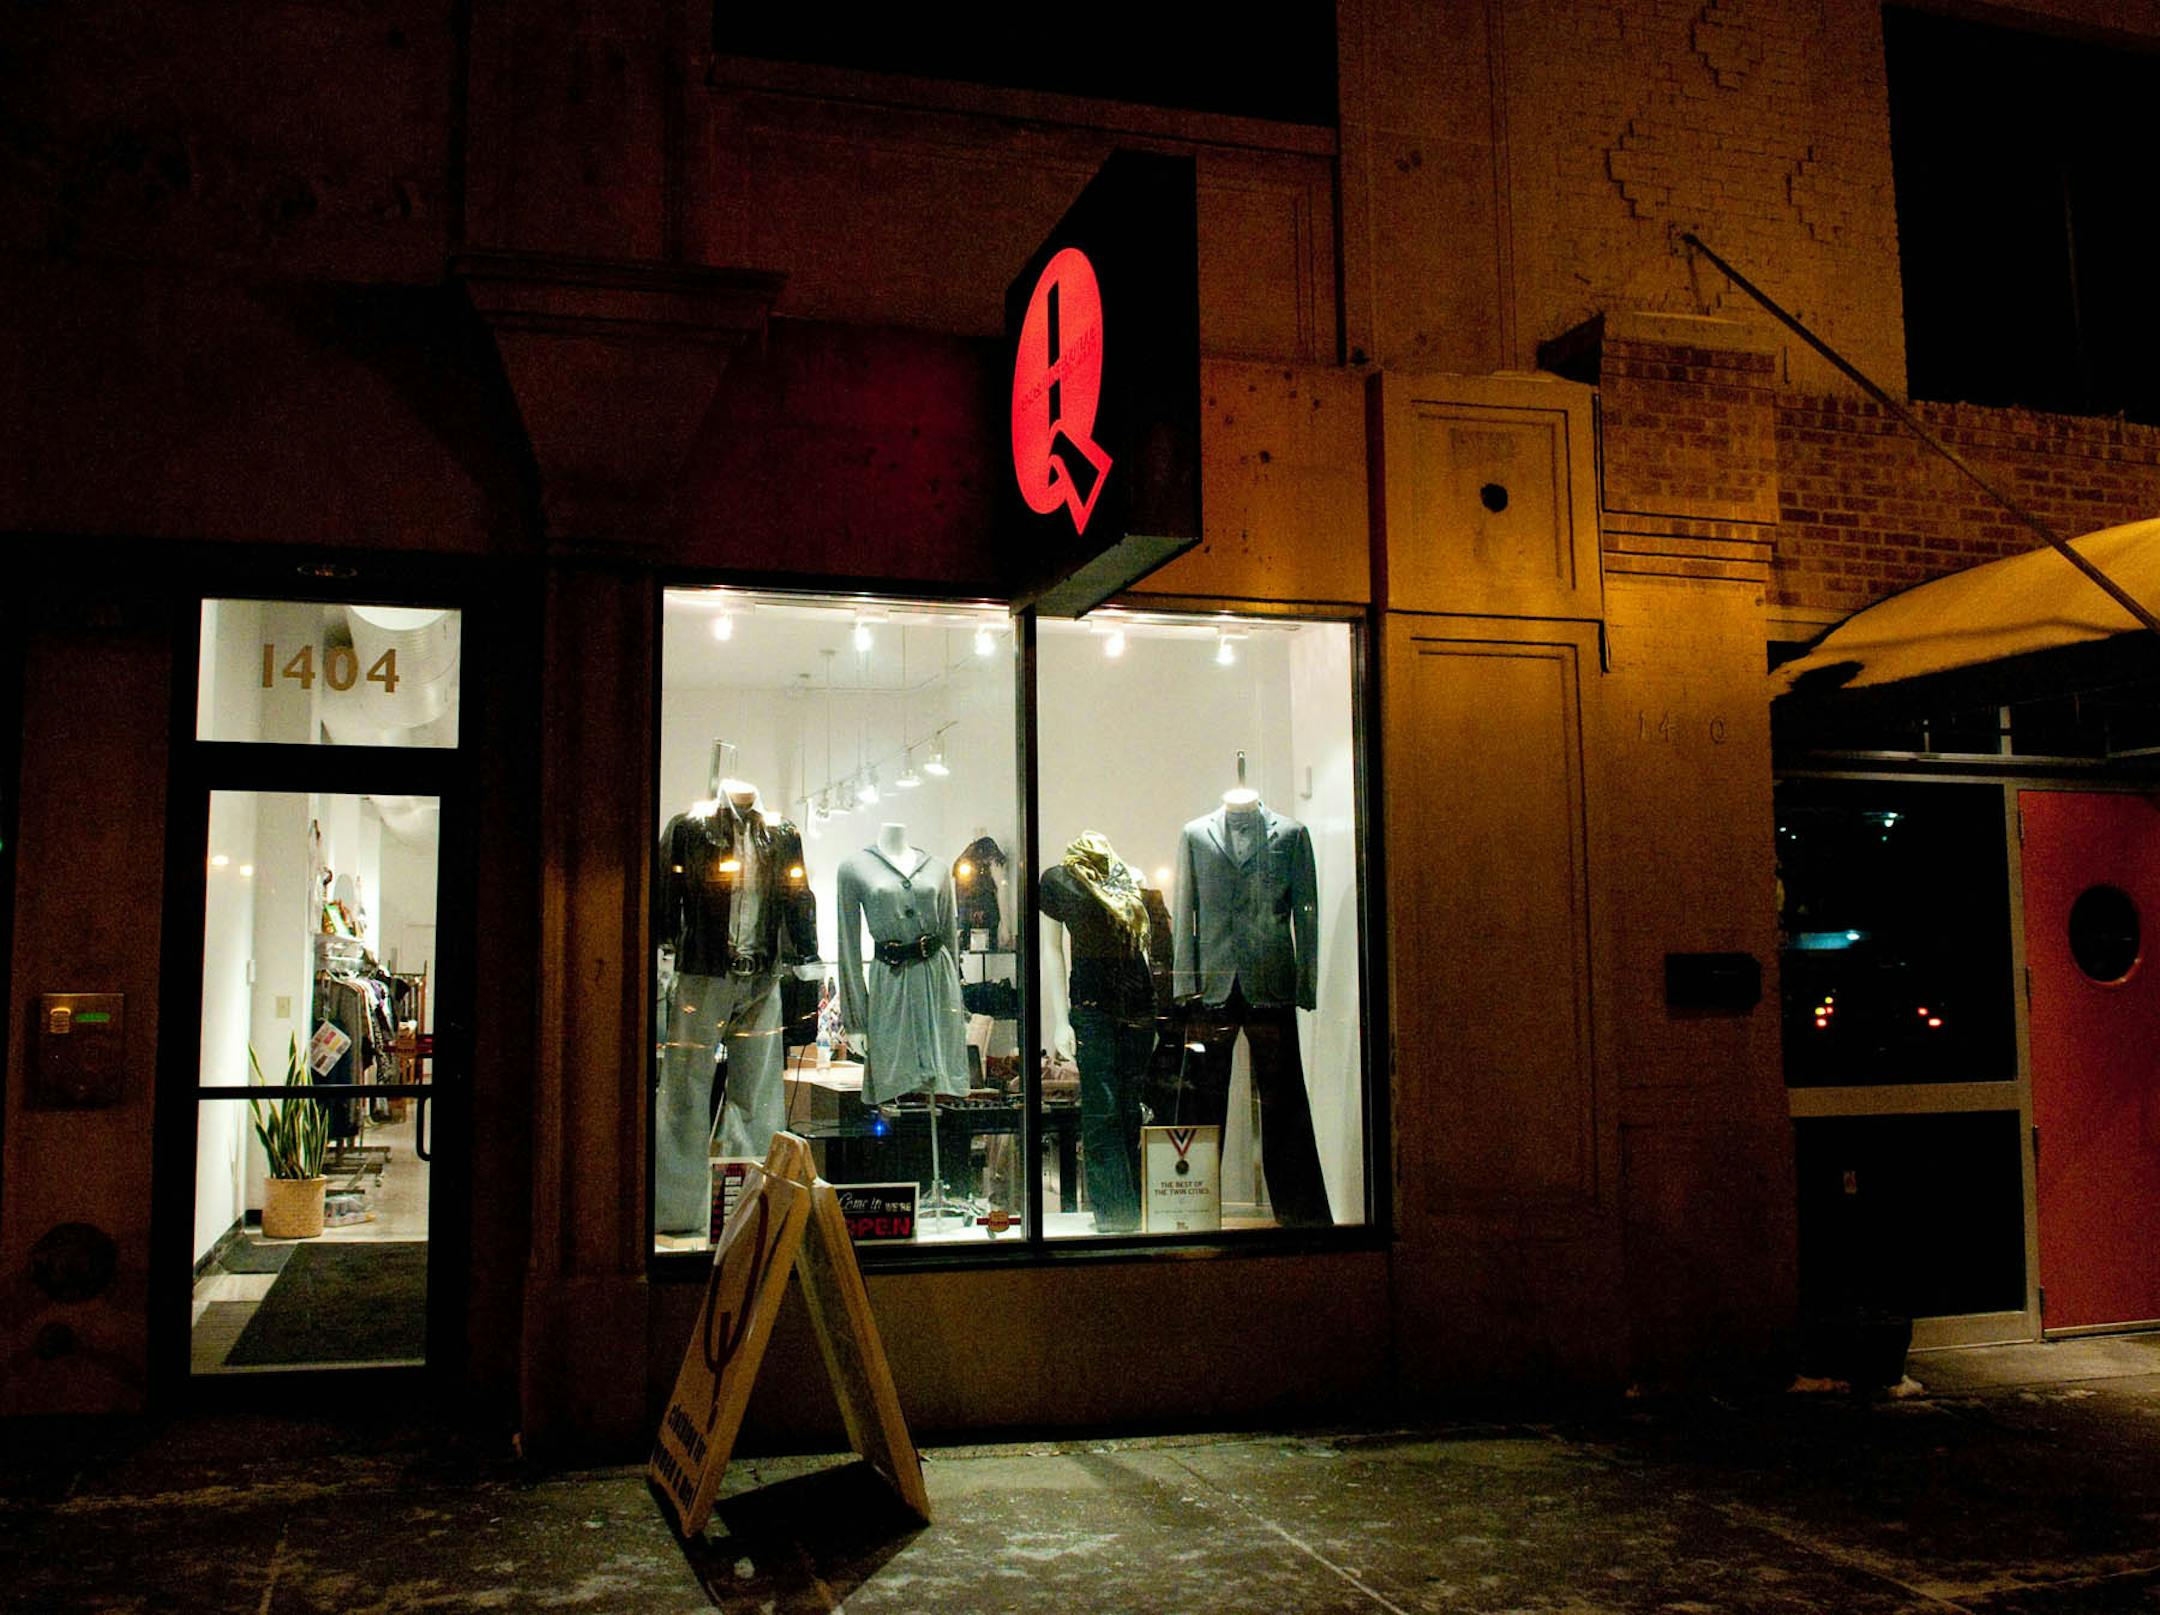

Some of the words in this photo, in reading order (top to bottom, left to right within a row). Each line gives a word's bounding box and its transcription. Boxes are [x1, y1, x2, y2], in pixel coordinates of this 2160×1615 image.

[1011, 247, 1113, 536] Q
[262, 644, 400, 693] 1404
[839, 1191, 868, 1210] Come
[869, 1196, 882, 1211] in
[845, 1216, 911, 1237] OPEN
